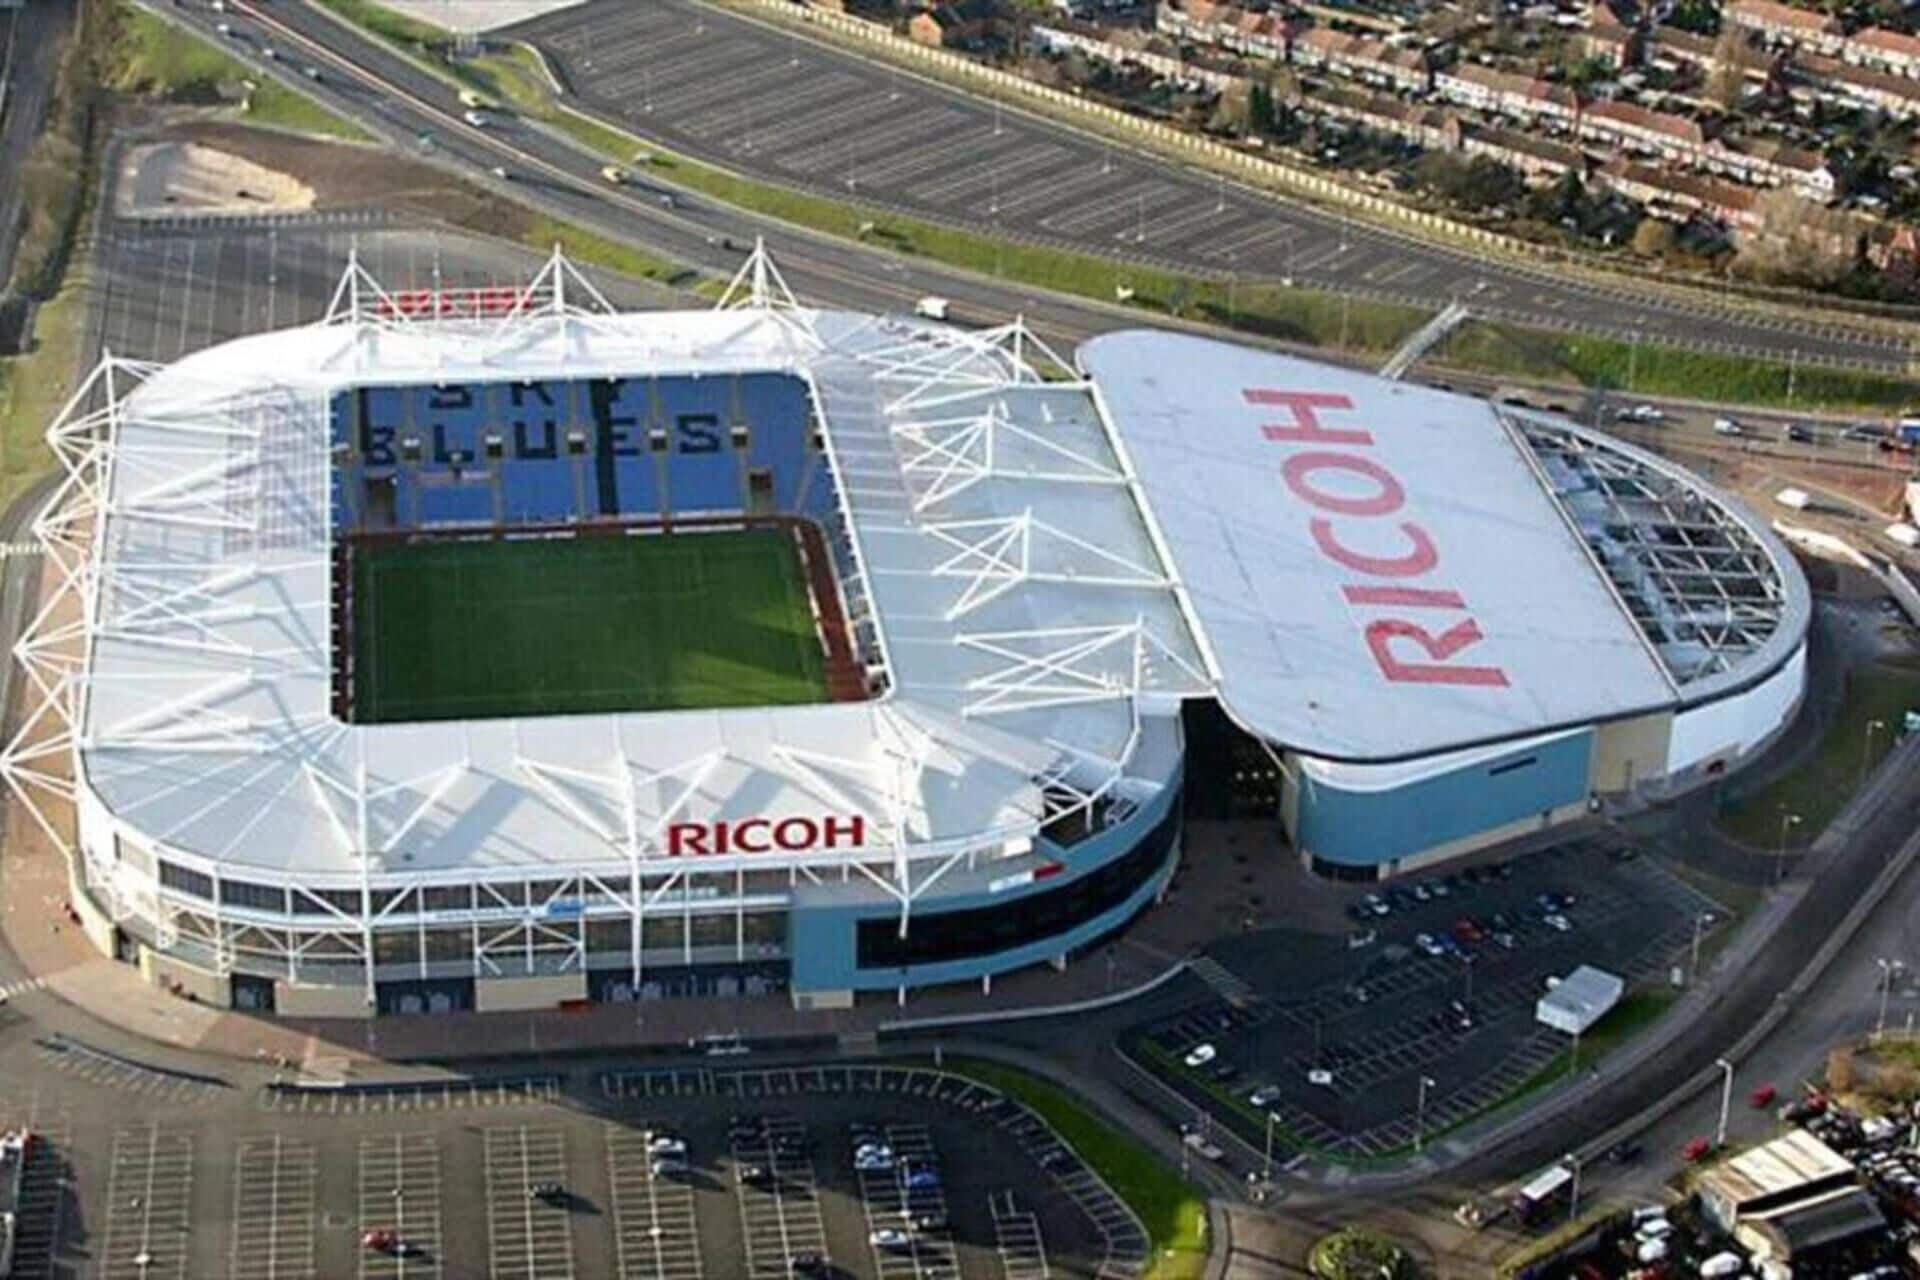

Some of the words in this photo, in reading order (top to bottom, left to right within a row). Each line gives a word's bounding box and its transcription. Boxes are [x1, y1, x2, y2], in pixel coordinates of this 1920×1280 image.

[365, 413, 720, 467] BLUES
[1242, 389, 1511, 687] RICOH
[668, 815, 864, 856] RICOH
